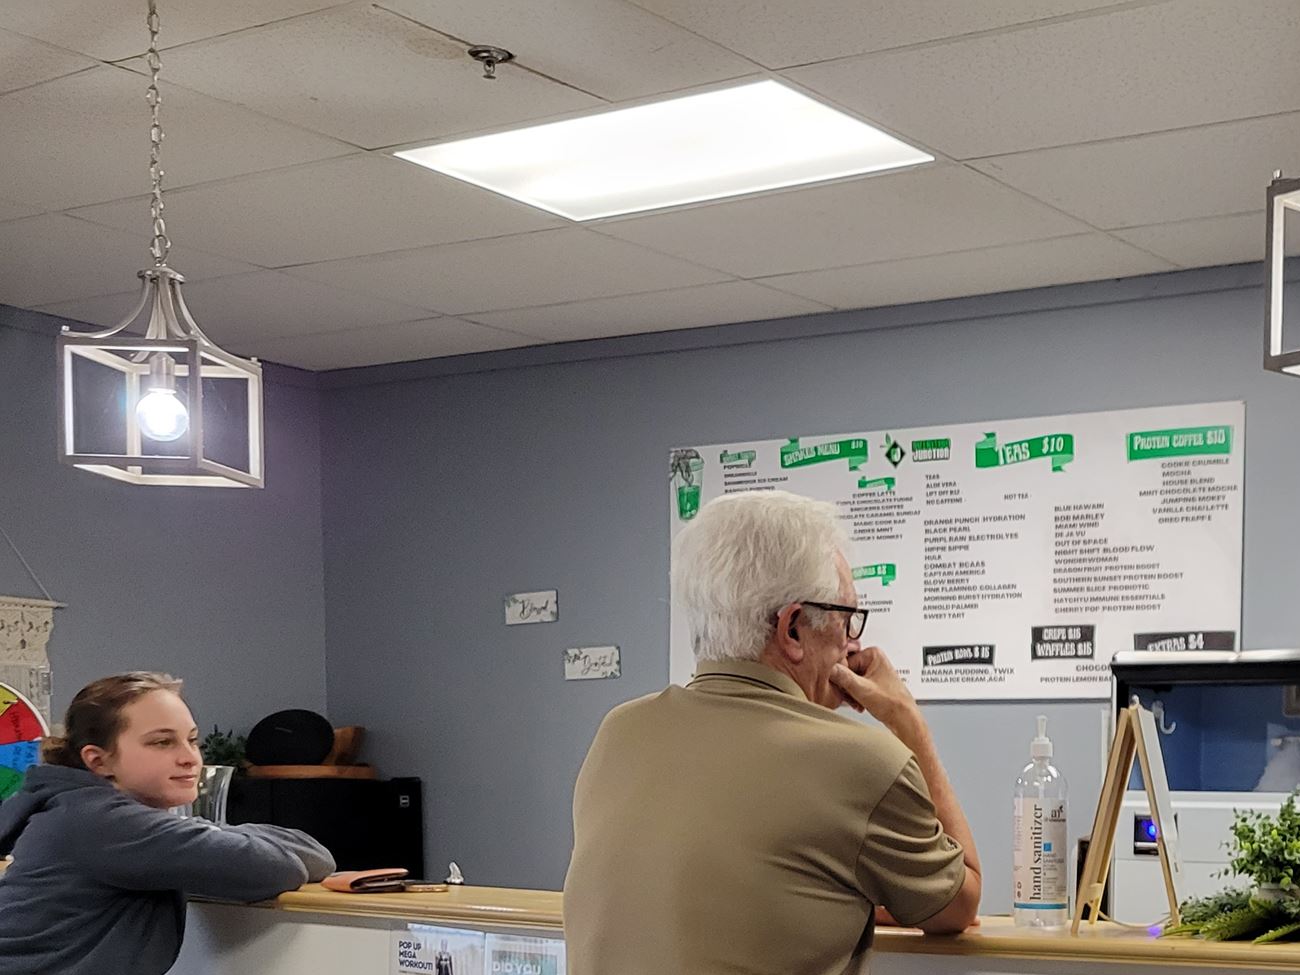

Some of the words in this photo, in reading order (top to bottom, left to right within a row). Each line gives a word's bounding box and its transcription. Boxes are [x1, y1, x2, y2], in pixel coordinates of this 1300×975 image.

[1134, 435, 1170, 450] PROTEIN
[1172, 433, 1204, 447] COFFEE
[994, 442, 1030, 466] TEAS
[1042, 436, 1064, 454] $10
[1162, 479, 1188, 487] HOUSE
[1190, 477, 1215, 485] BLEND
[954, 516, 980, 524] PUNCH
[983, 514, 1026, 522] HYDRATION
[1072, 513, 1105, 521] MARLEY
[1103, 546, 1130, 554] BLOOD
[924, 562, 956, 570] COMBAT
[955, 569, 986, 577] AMERICA
[1053, 576, 1093, 584] SOUTHERN
[981, 592, 1023, 600] HYDRATION
[1102, 604, 1134, 612] PROTEIN
[1135, 603, 1161, 611] BOOST
[1187, 633, 1204, 649] $4
[1036, 641, 1076, 657] WAFFLES
[921, 668, 953, 676] BANANA
[994, 667, 1015, 675] TWIX
[1031, 803, 1043, 864] sanitizer
[1030, 865, 1042, 900] hand
[398, 941, 412, 950] POP
[413, 942, 422, 950] UP
[398, 950, 417, 959] MEGA
[492, 961, 513, 973] DID
